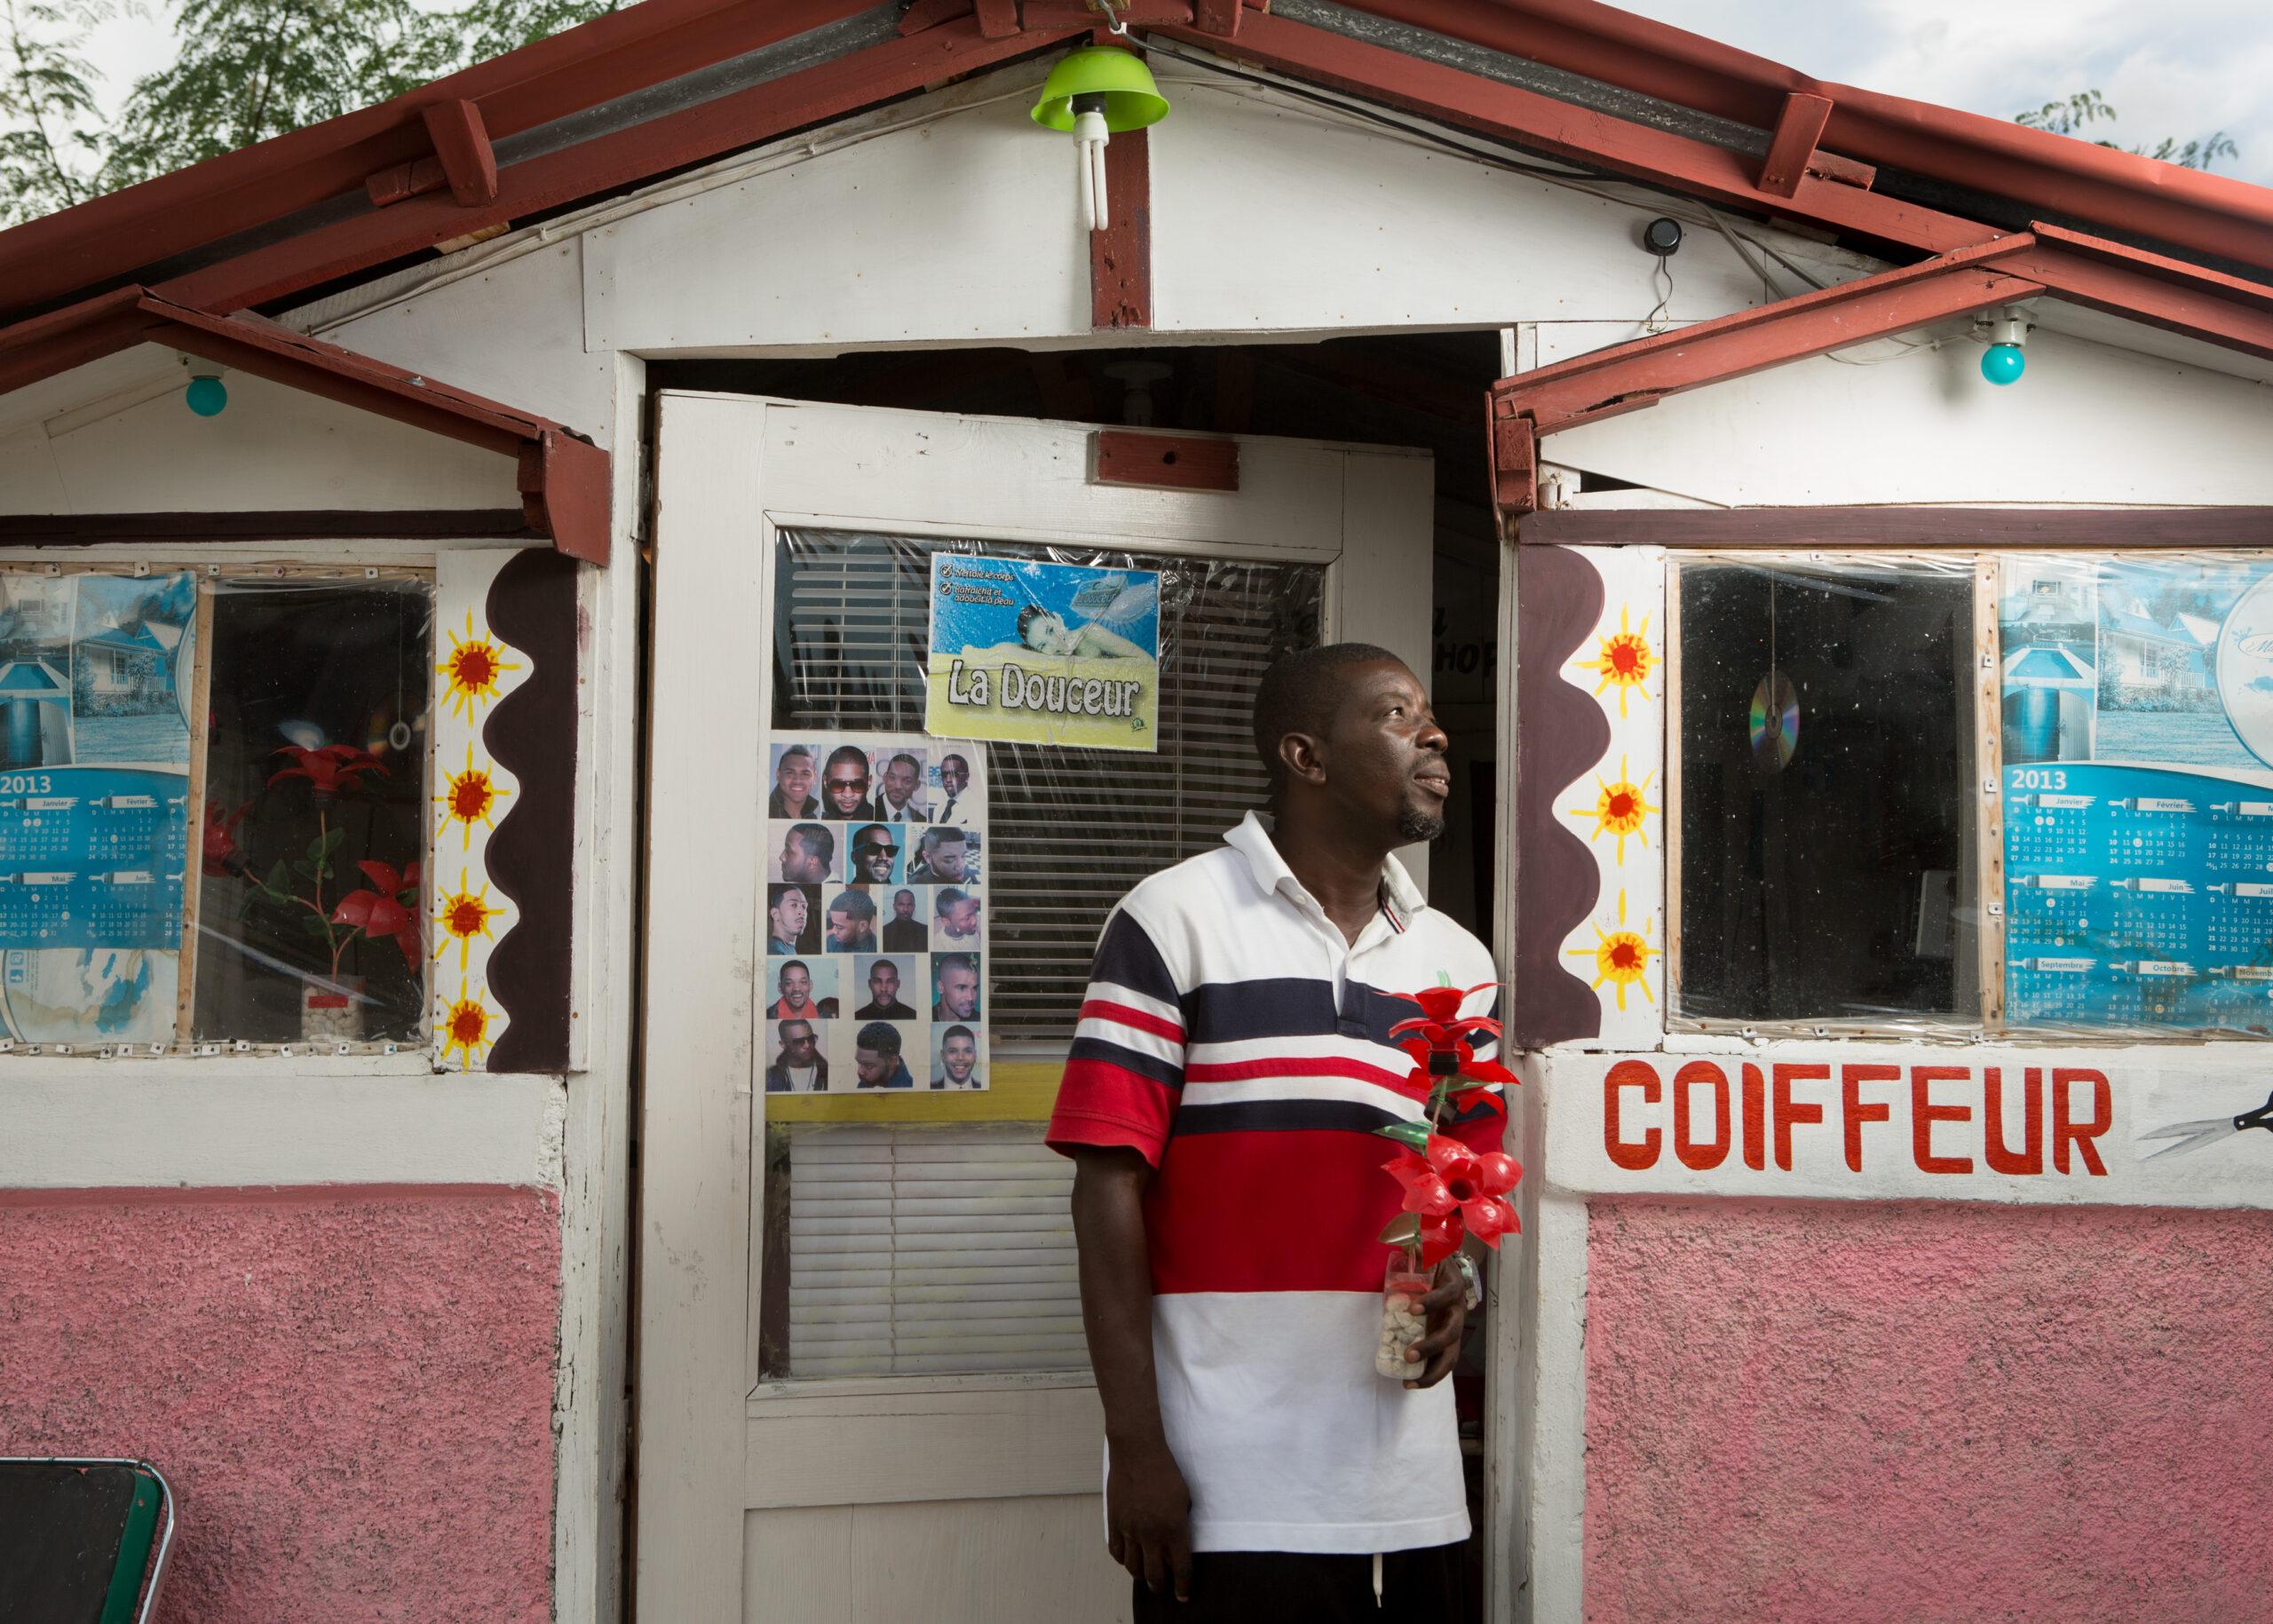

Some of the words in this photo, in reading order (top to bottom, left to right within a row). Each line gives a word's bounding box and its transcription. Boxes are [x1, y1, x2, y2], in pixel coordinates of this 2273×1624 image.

[955, 568, 984, 579] Nettoie
[993, 573, 1015, 582] corps
[994, 597, 1014, 606] peau
[948, 659, 989, 706] La
[1001, 662, 1141, 717] Douceur
[0, 775, 51, 794] 2013
[2011, 769, 2067, 790] 2013
[1604, 1059, 2112, 1176] COIFFEUR
